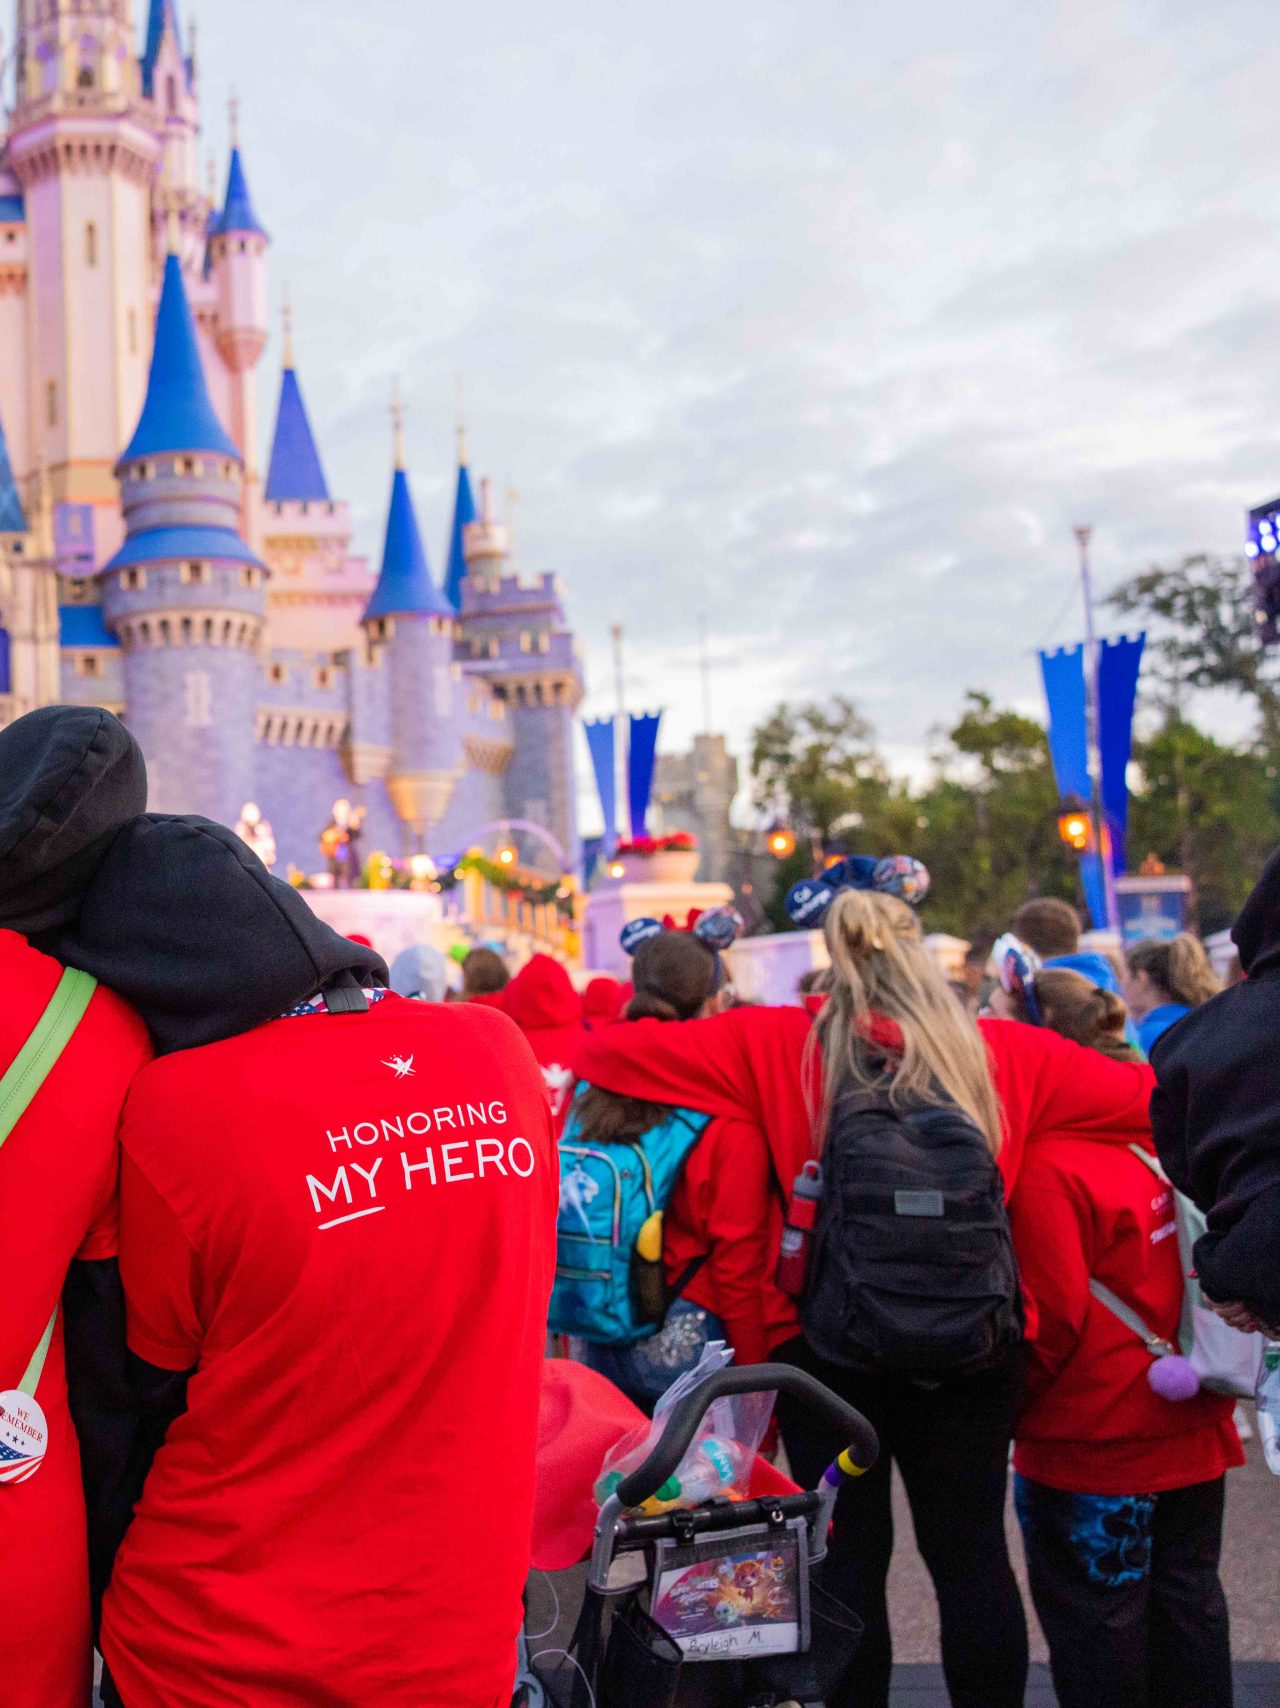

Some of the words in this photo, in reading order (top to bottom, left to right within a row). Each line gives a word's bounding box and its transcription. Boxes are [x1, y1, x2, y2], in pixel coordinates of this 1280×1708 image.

[326, 1100, 508, 1153] HONORING
[305, 1156, 384, 1213] MY
[400, 1137, 535, 1191] HERO
[1, 1412, 43, 1444] EMEMBER
[17, 1407, 30, 1421] WE
[747, 1630, 763, 1645] M
